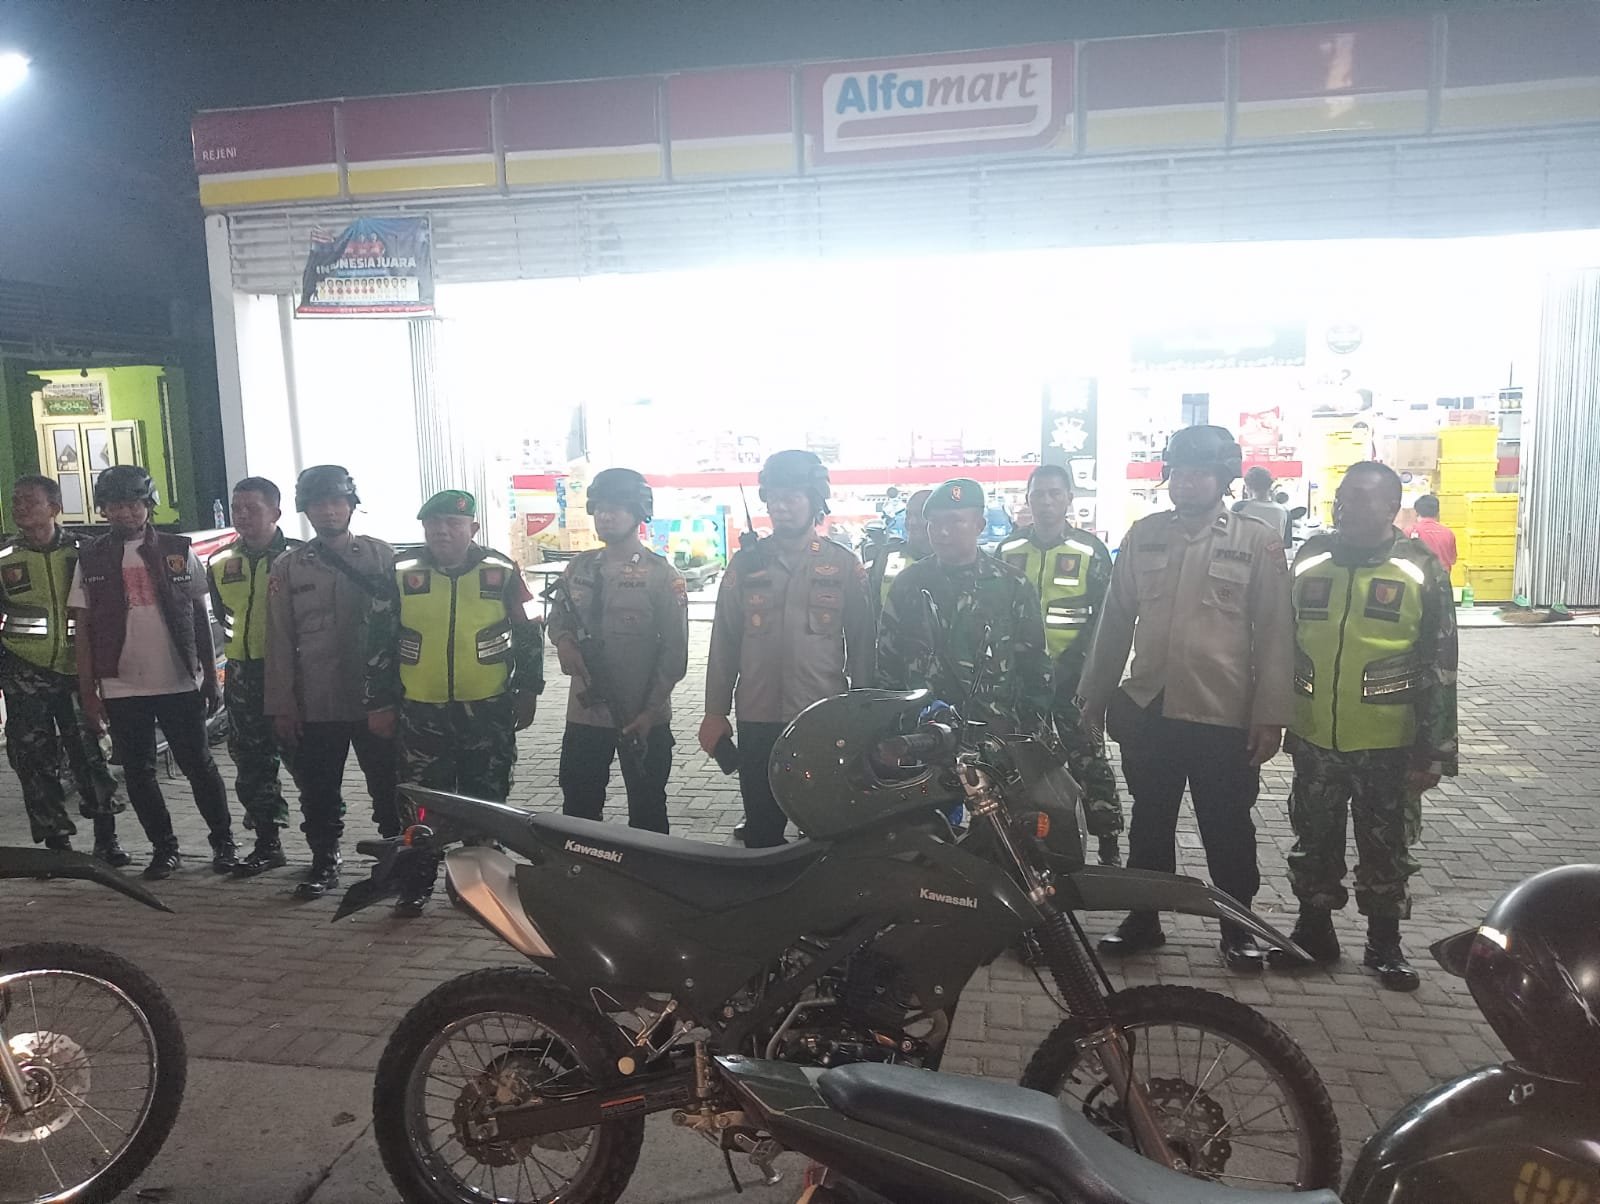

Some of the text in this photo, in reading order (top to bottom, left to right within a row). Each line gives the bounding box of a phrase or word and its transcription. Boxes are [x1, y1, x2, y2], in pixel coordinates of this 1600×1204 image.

[835, 63, 1038, 115] Alfamart
[203, 147, 237, 161] REJENI
[376, 256, 417, 269] JUARA
[1216, 548, 1252, 563] POLRI
[564, 839, 624, 863] Kawasaki
[919, 887, 978, 909] Kawasaki
